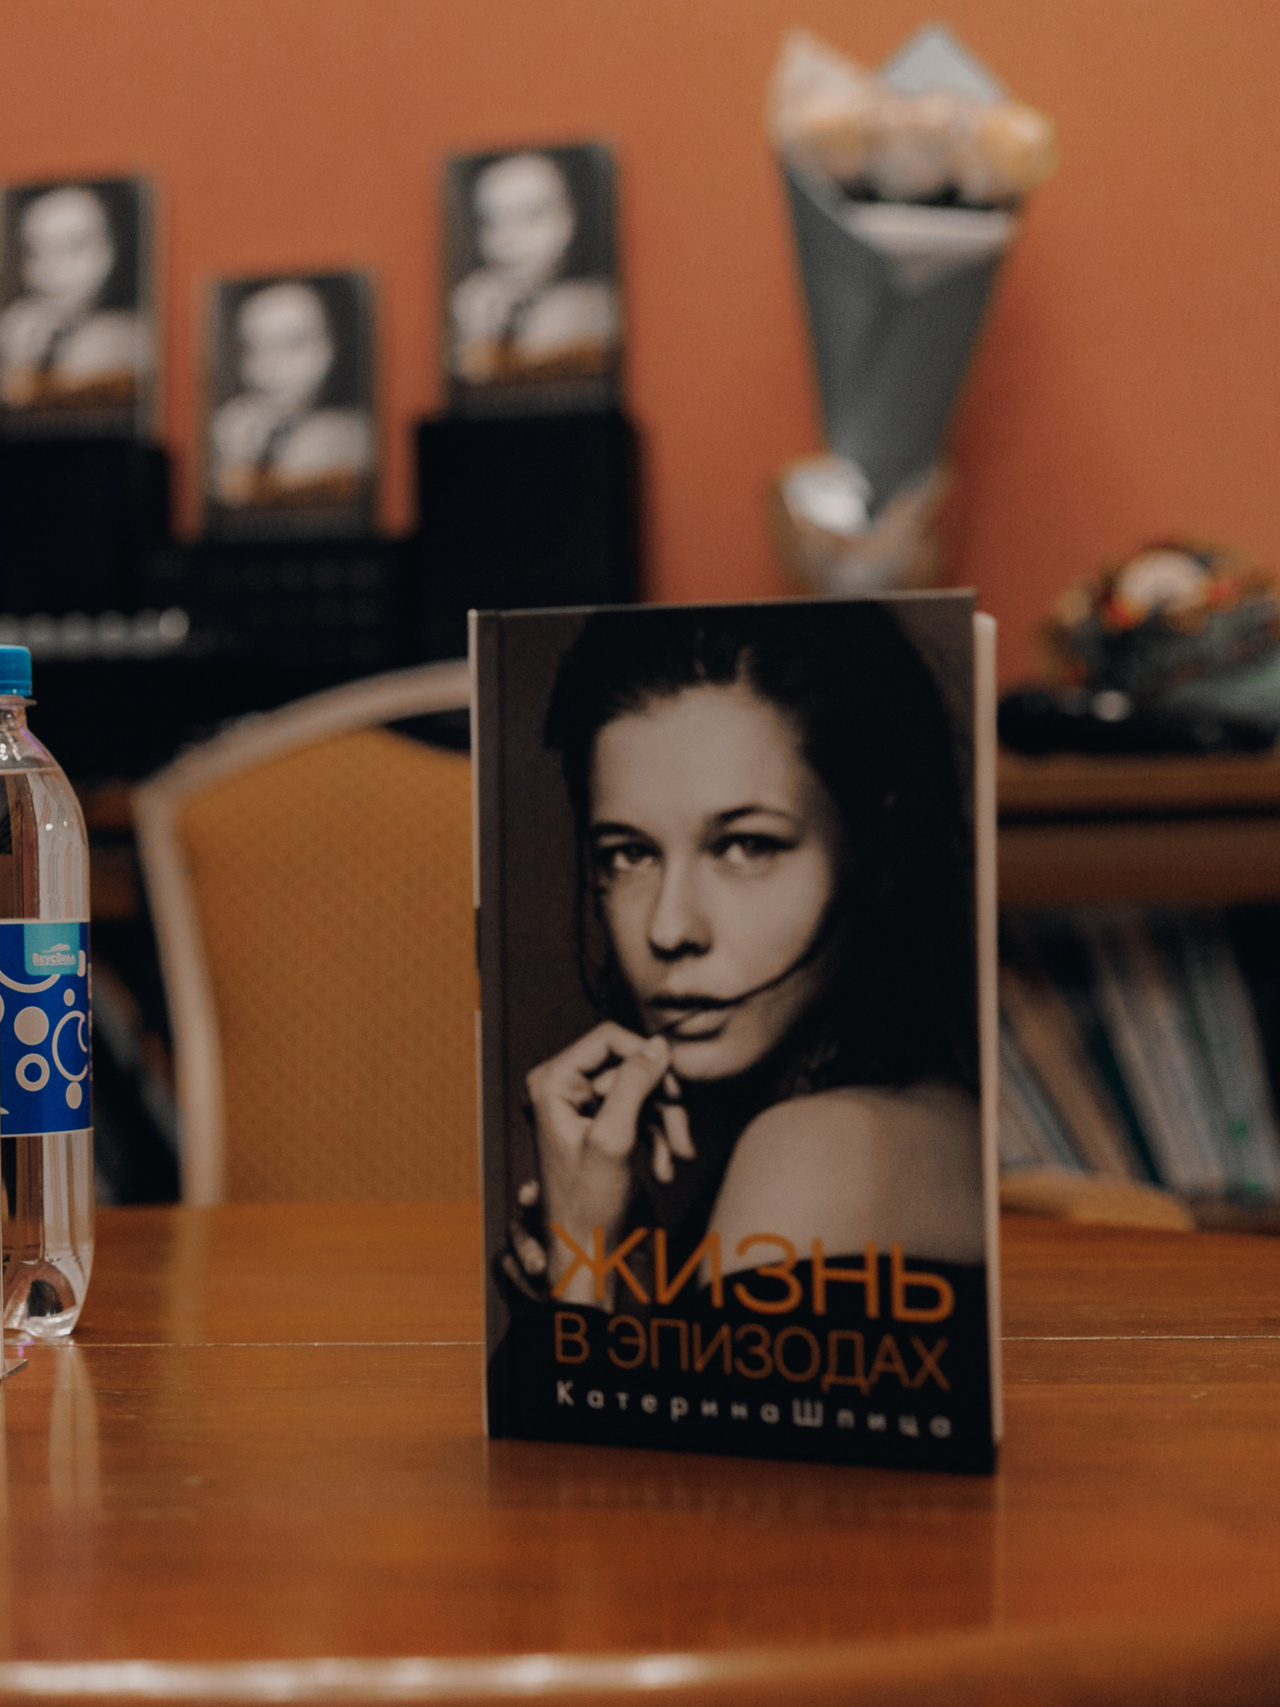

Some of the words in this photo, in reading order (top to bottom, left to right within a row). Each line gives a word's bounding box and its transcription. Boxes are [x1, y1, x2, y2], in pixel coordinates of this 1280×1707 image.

[550, 1222, 956, 1324] ЖИЗНЬ
[554, 1311, 591, 1364] В
[606, 1314, 951, 1395] ЭПИЗОДАХ
